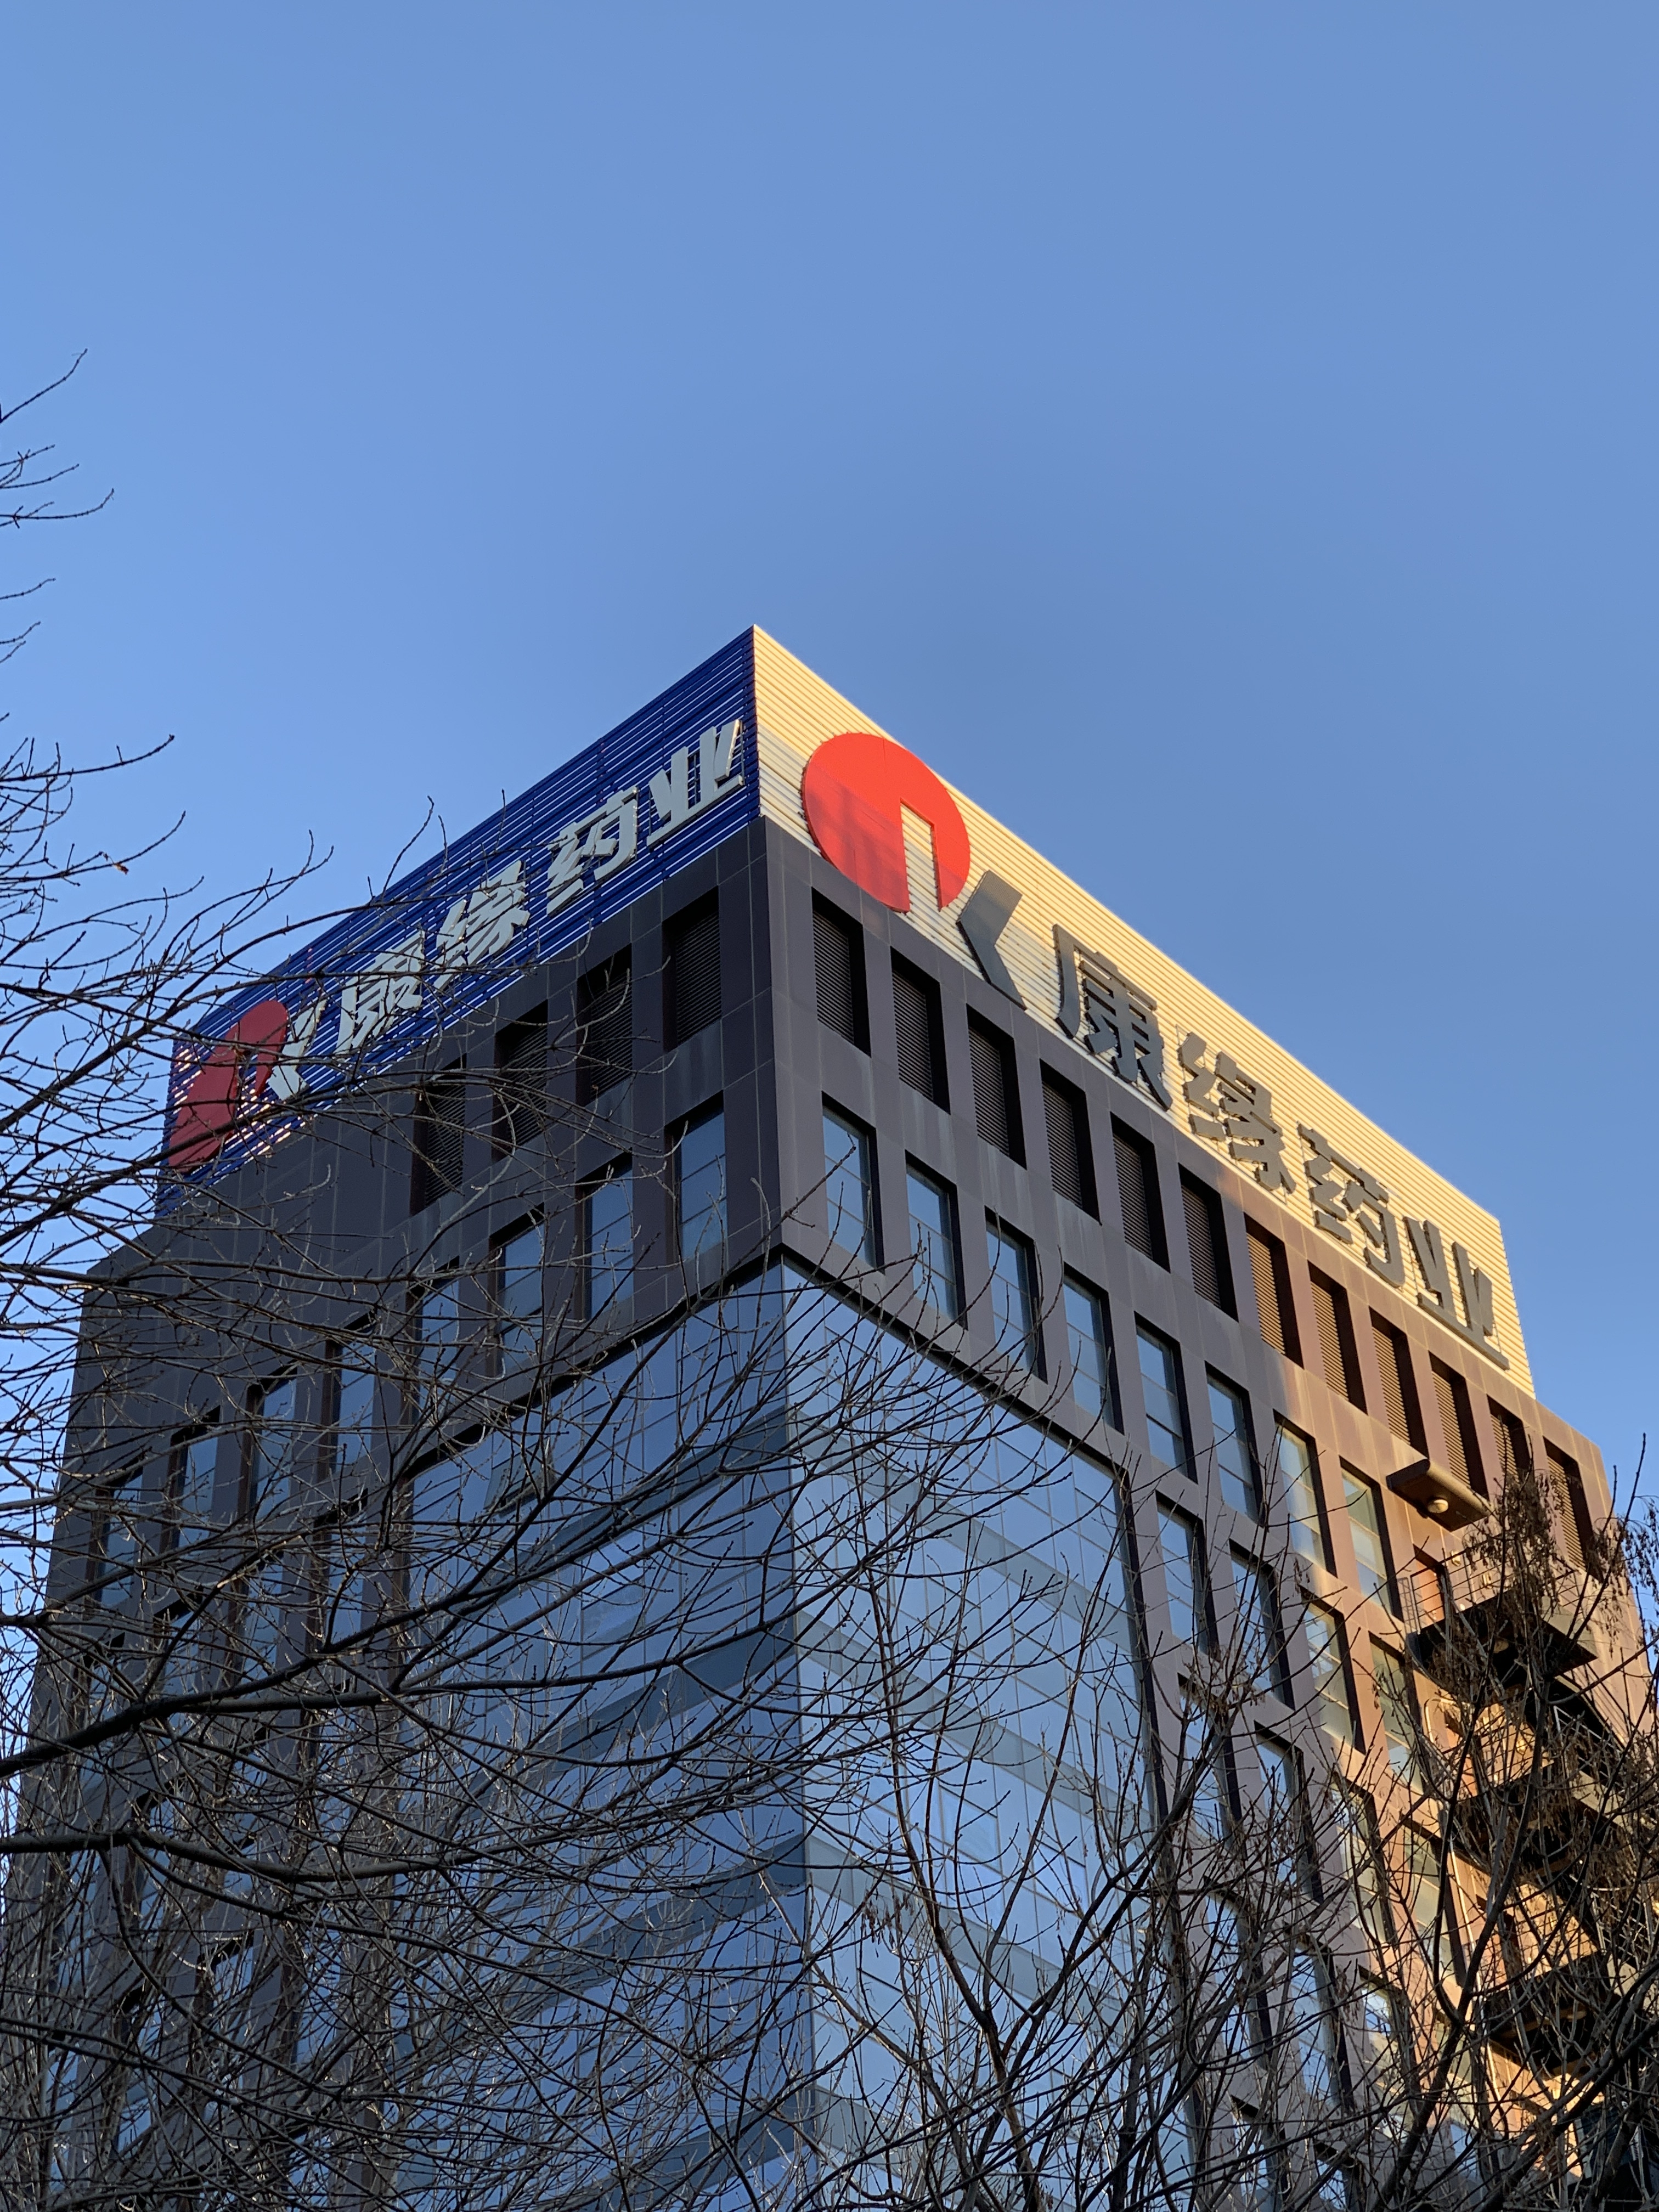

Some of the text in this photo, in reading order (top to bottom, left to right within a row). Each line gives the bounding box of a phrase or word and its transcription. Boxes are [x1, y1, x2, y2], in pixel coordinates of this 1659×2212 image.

[336, 719, 744, 1053] 康缘药业
[1052, 924, 1509, 1370] 康缘药业
